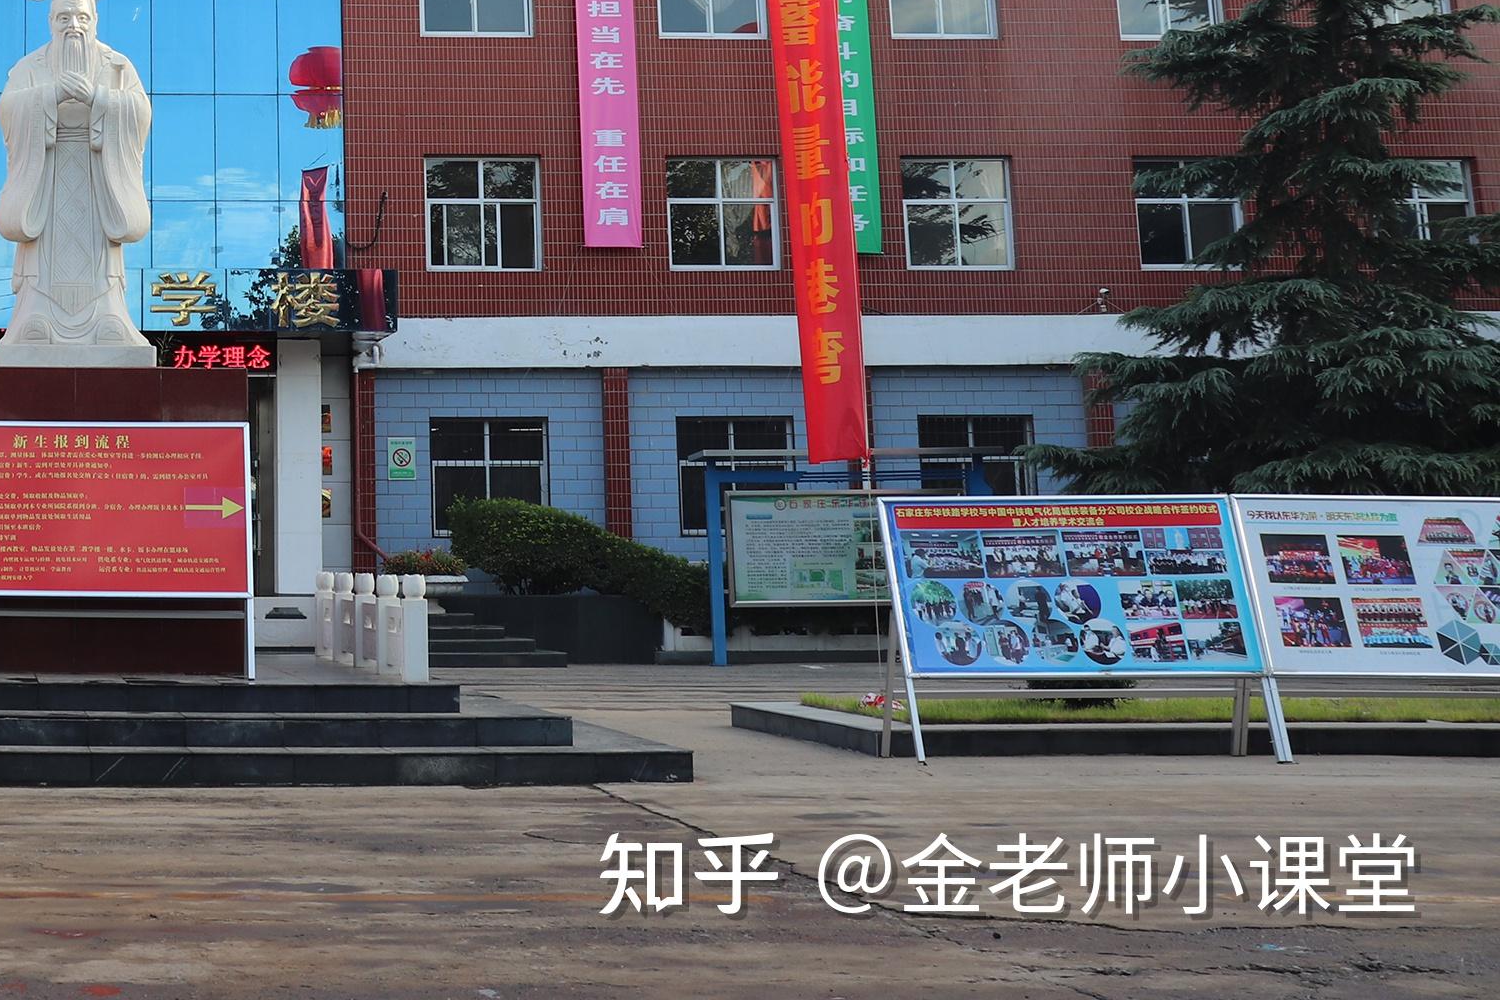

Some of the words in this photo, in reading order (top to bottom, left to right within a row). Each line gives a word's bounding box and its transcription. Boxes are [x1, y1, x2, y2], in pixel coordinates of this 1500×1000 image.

[587, 0, 625, 95] 担当在先
[592, 129, 630, 227] 重任在肩
[174, 344, 271, 369] 办学理念
[12, 434, 130, 449] 新生报到流程
